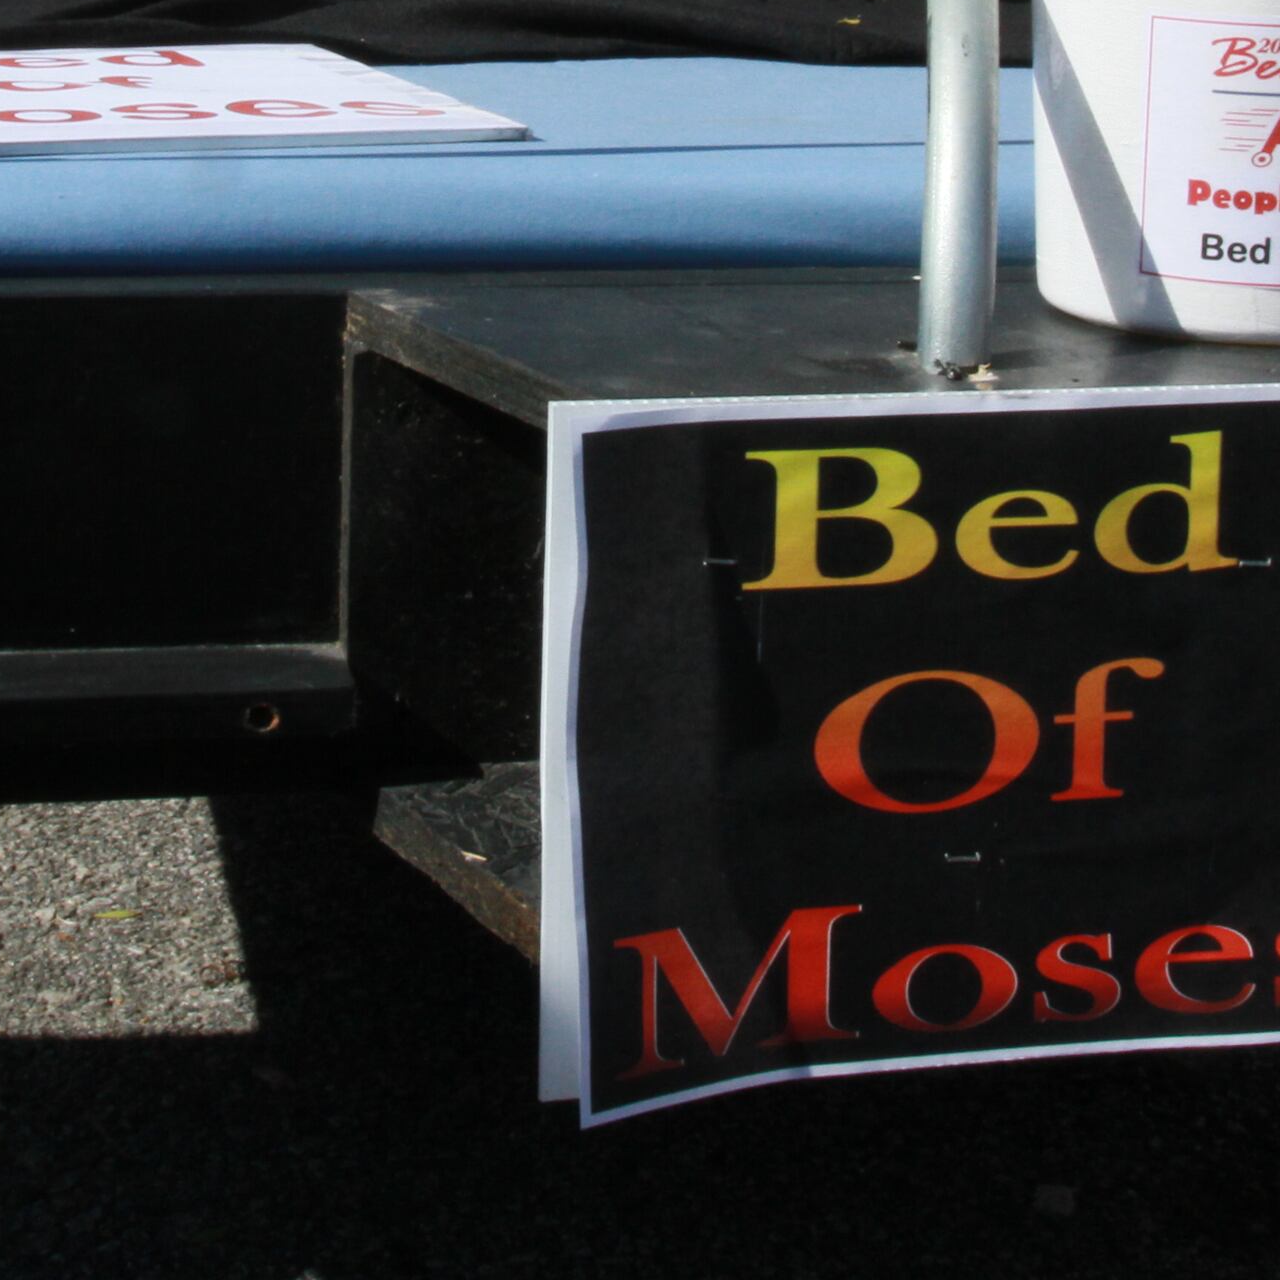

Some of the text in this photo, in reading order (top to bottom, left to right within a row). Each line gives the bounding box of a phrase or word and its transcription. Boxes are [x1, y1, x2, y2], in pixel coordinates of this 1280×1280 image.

[1200, 232, 1272, 265] Bed
[740, 429, 1240, 592] Bed
[812, 657, 1166, 815] Of
